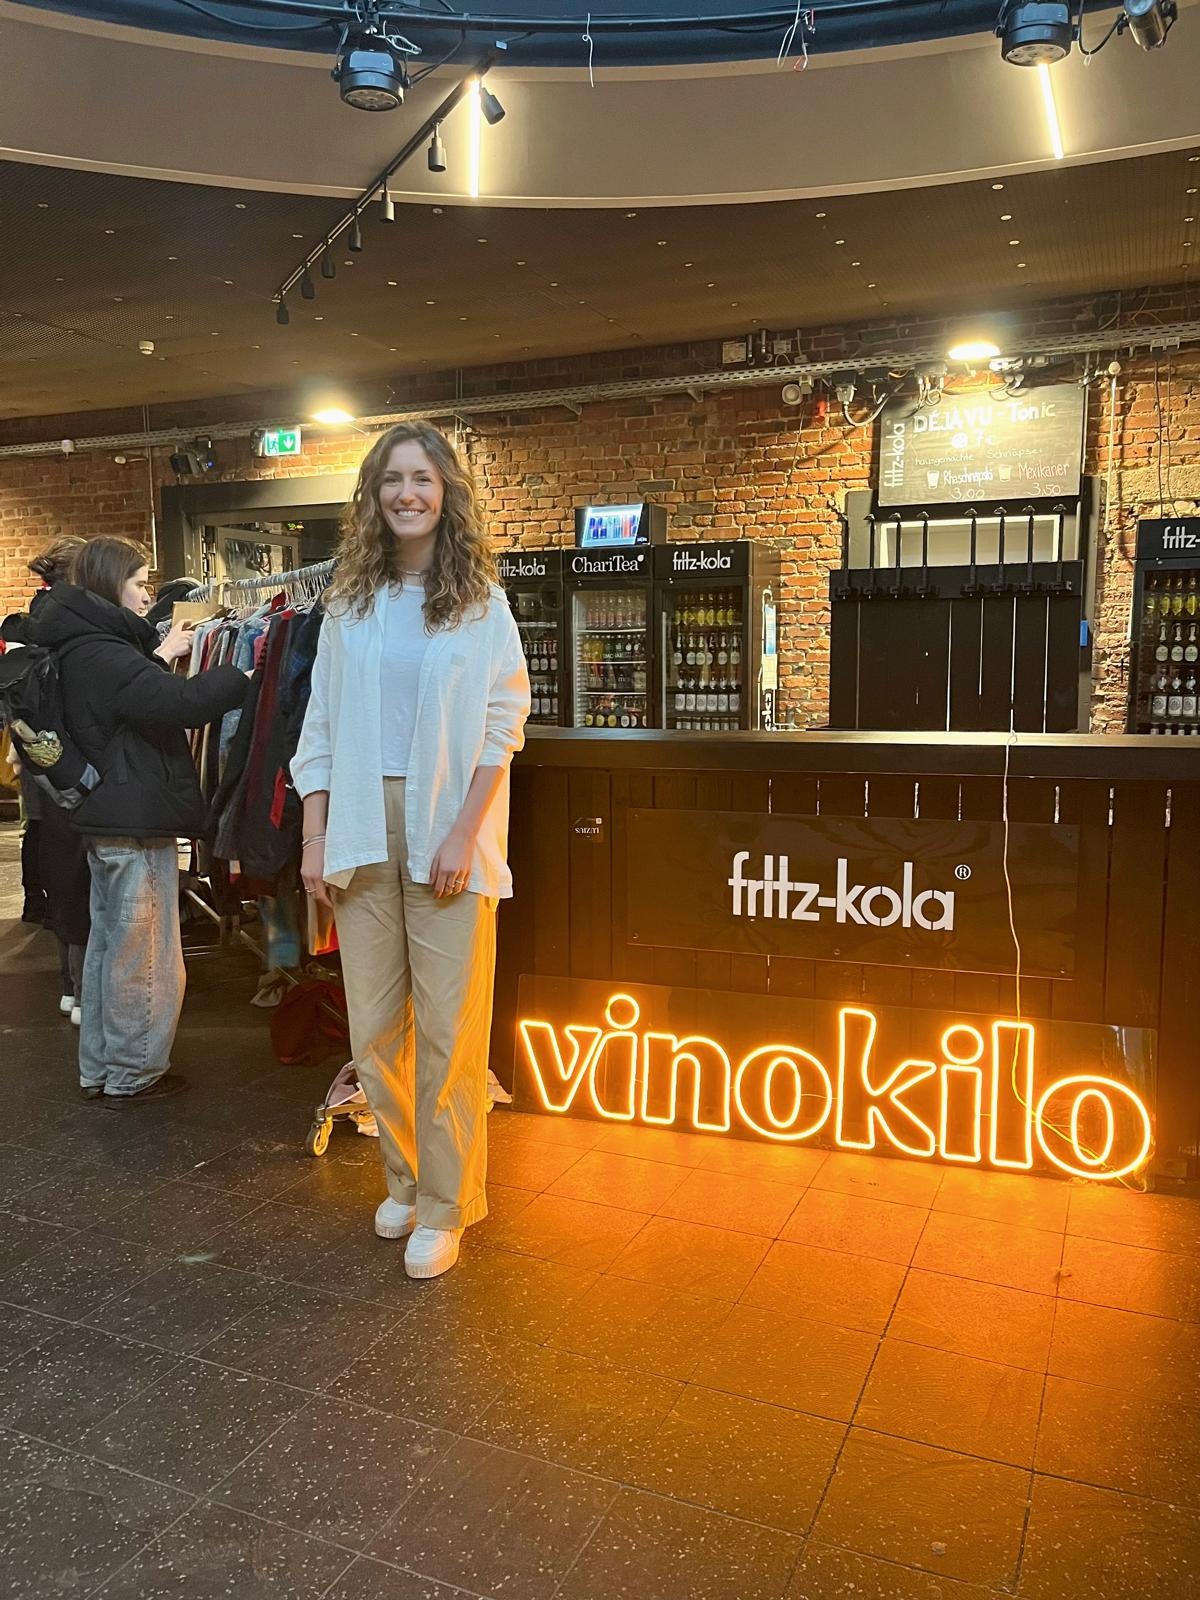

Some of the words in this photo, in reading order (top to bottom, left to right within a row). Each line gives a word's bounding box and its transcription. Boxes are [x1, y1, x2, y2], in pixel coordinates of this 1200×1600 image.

[1006, 401, 1056, 423] Tonic
[883, 423, 905, 487] fritz-kola
[1018, 461, 1070, 481] Mexikaner
[571, 555, 641, 573] ChariTea
[672, 550, 731, 571] fritz-kola
[728, 851, 955, 931] fritz-kola
[518, 994, 1152, 1180] vinokilo
